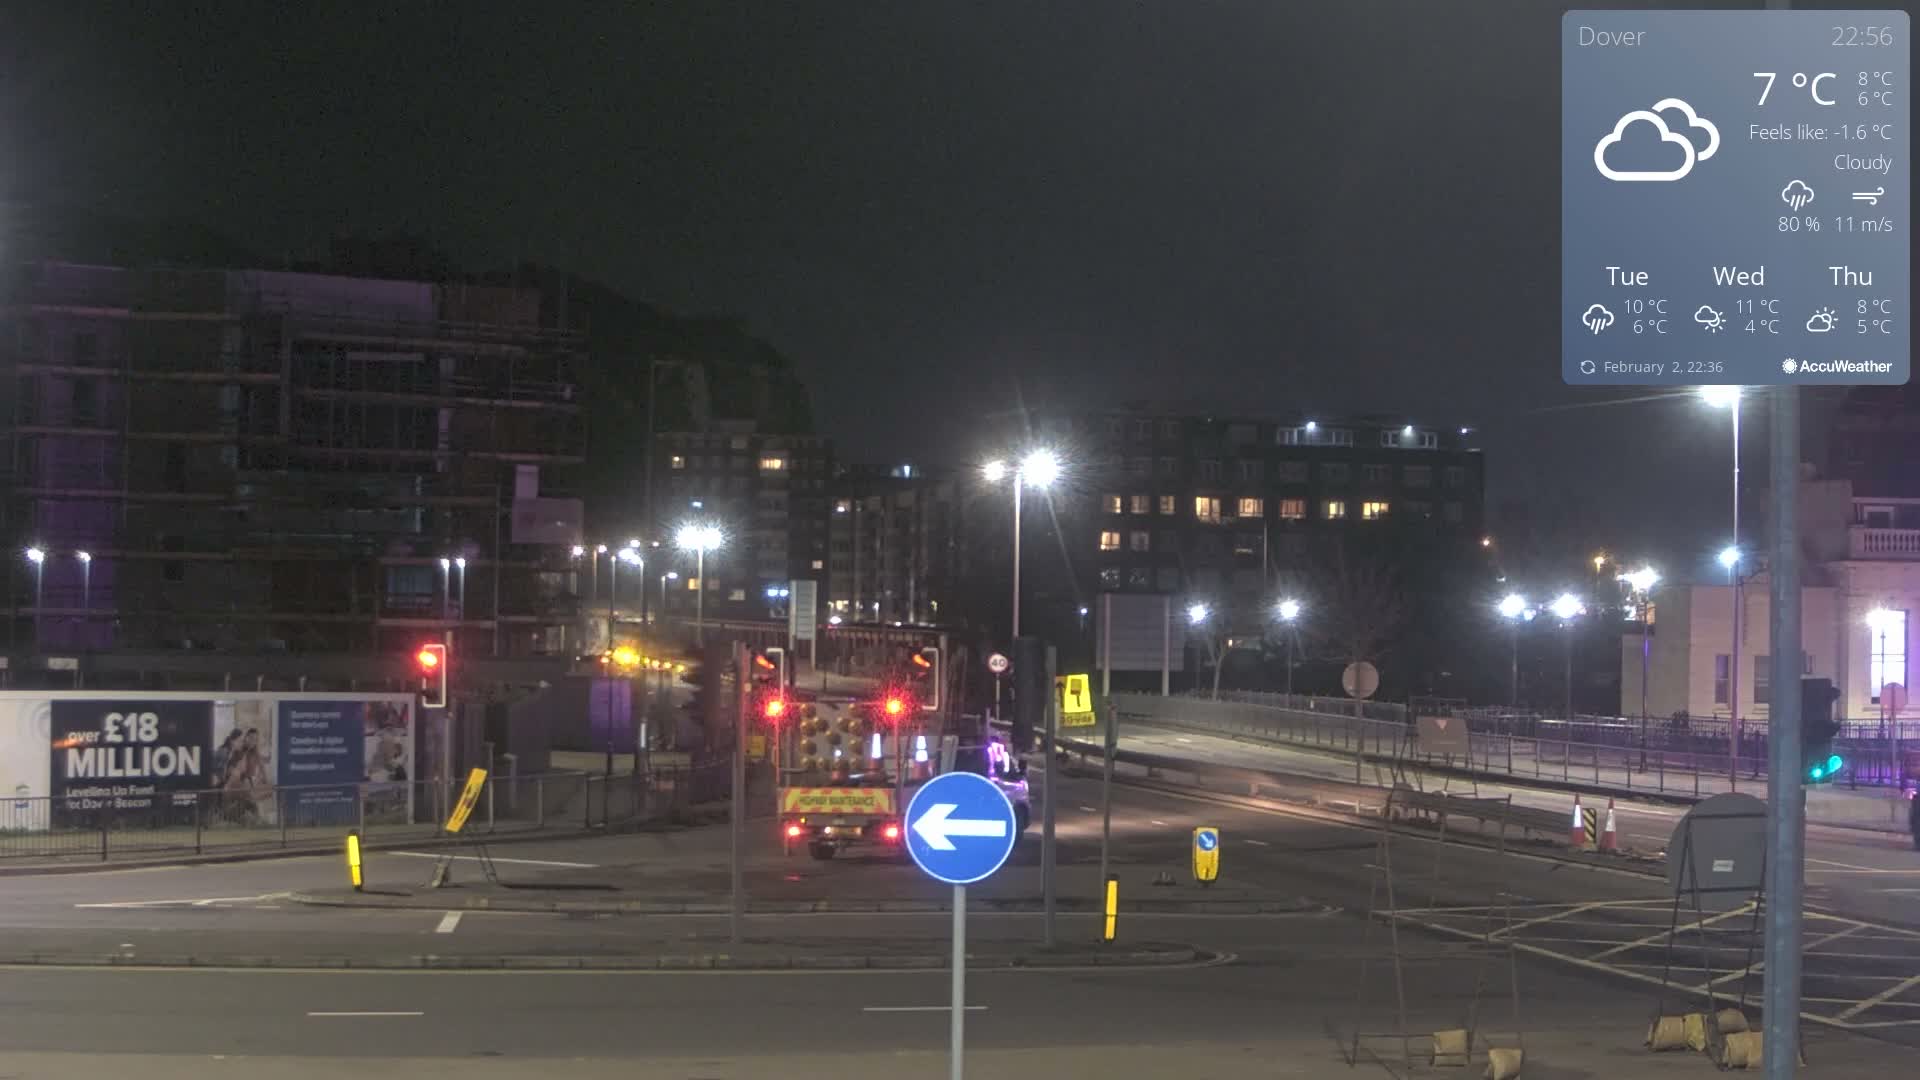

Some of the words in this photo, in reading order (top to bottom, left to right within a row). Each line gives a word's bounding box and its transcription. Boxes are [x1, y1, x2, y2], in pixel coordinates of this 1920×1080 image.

[991, 658, 1006, 667] 40
[68, 731, 101, 743] over
[104, 711, 159, 743] £18
[66, 746, 201, 778] MILLION
